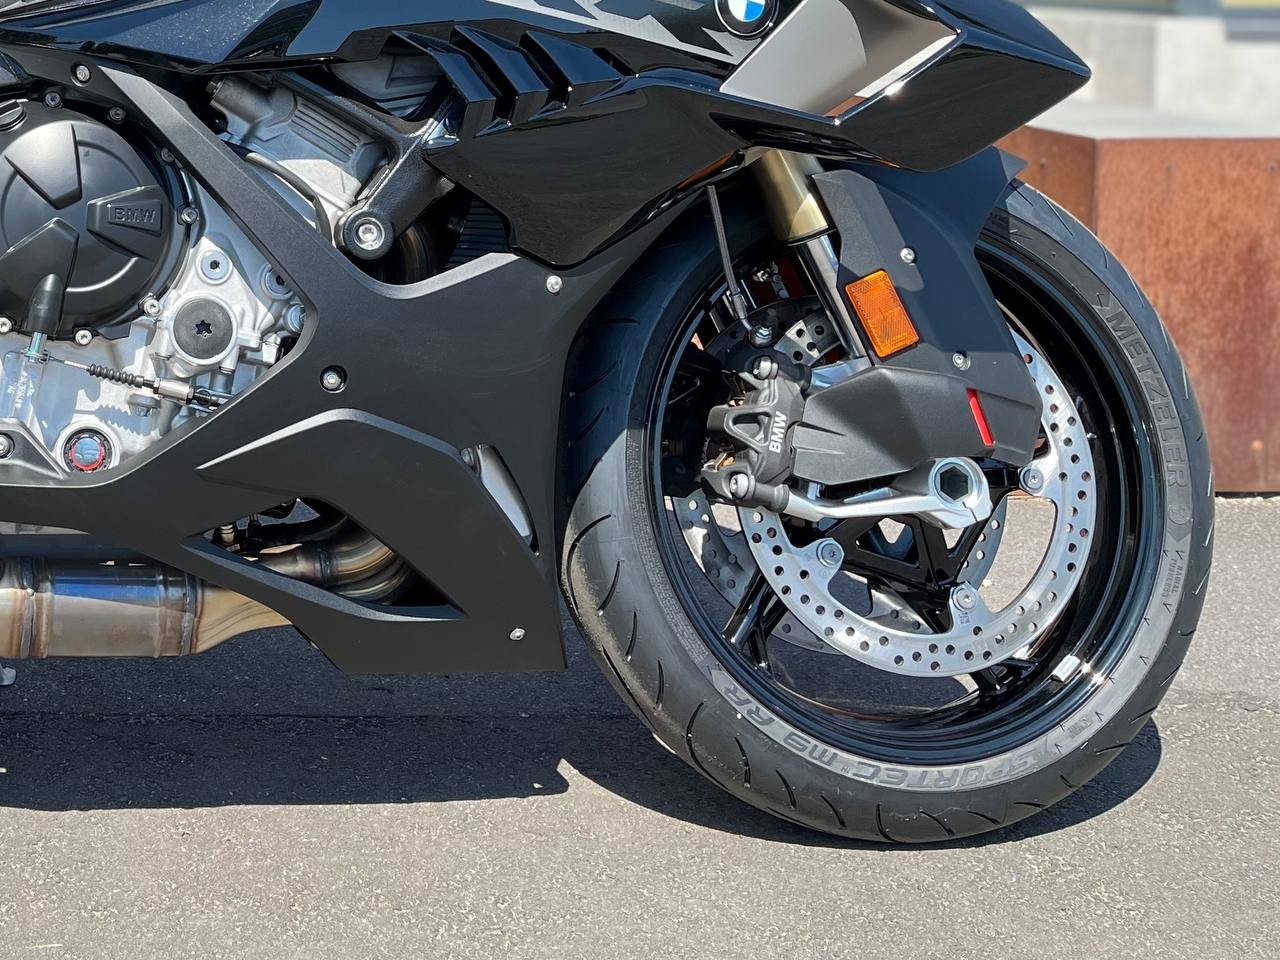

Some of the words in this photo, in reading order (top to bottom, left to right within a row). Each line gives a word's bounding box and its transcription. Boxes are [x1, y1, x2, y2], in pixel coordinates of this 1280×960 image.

[114, 207, 156, 223] BMW
[1105, 309, 1189, 489] METZELER
[768, 411, 787, 454] BMW
